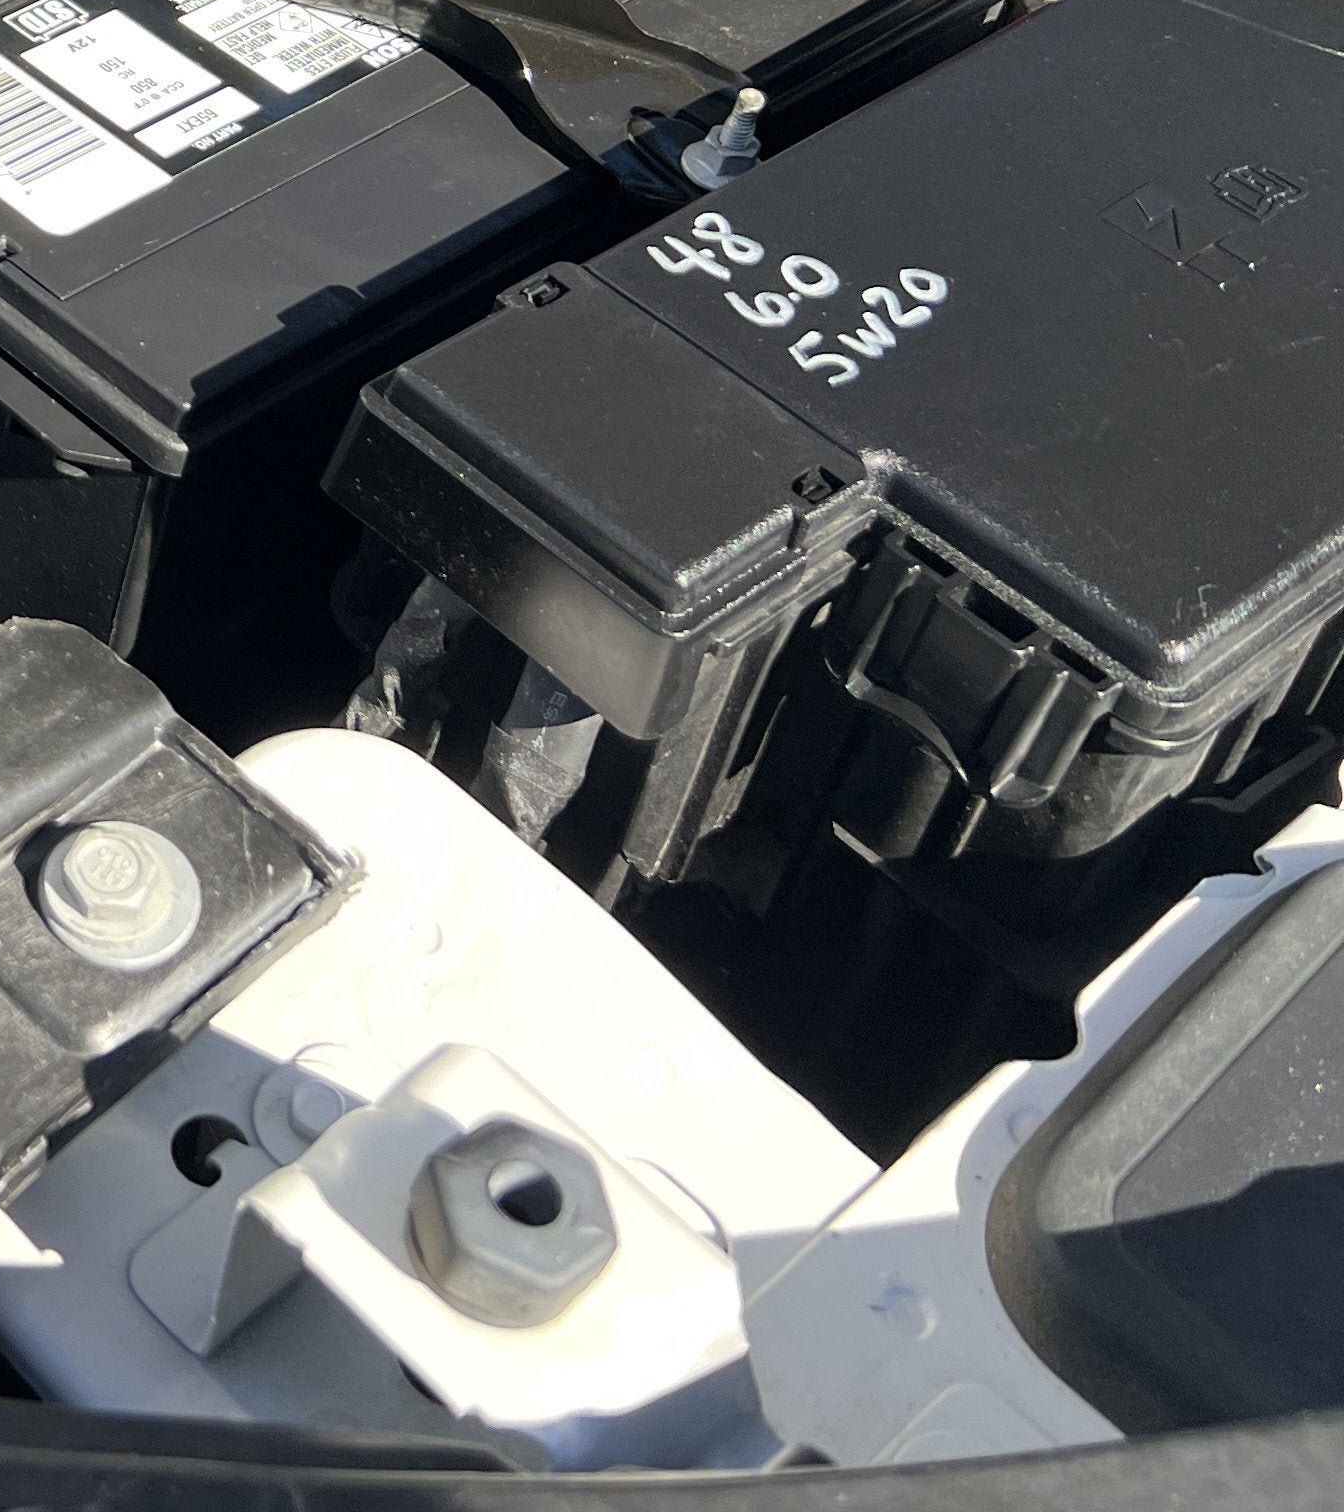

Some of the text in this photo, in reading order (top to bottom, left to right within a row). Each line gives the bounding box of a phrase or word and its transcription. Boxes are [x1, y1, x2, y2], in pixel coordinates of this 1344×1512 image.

[245, 19, 273, 35] HELP
[307, 27, 337, 44] WITH
[63, 33, 98, 53] 12V
[230, 31, 277, 57] MEDICAL
[242, 51, 267, 65] GET
[282, 35, 350, 72] IMMEDIATELY
[302, 43, 362, 76] FLUSH EYES
[96, 55, 127, 73] 150
[116, 68, 135, 79] RC
[128, 76, 158, 94] 850
[159, 80, 185, 95] CCA
[173, 107, 219, 133] 65EXT
[189, 121, 244, 152] PART NO.
[723, 254, 840, 327] 6.0
